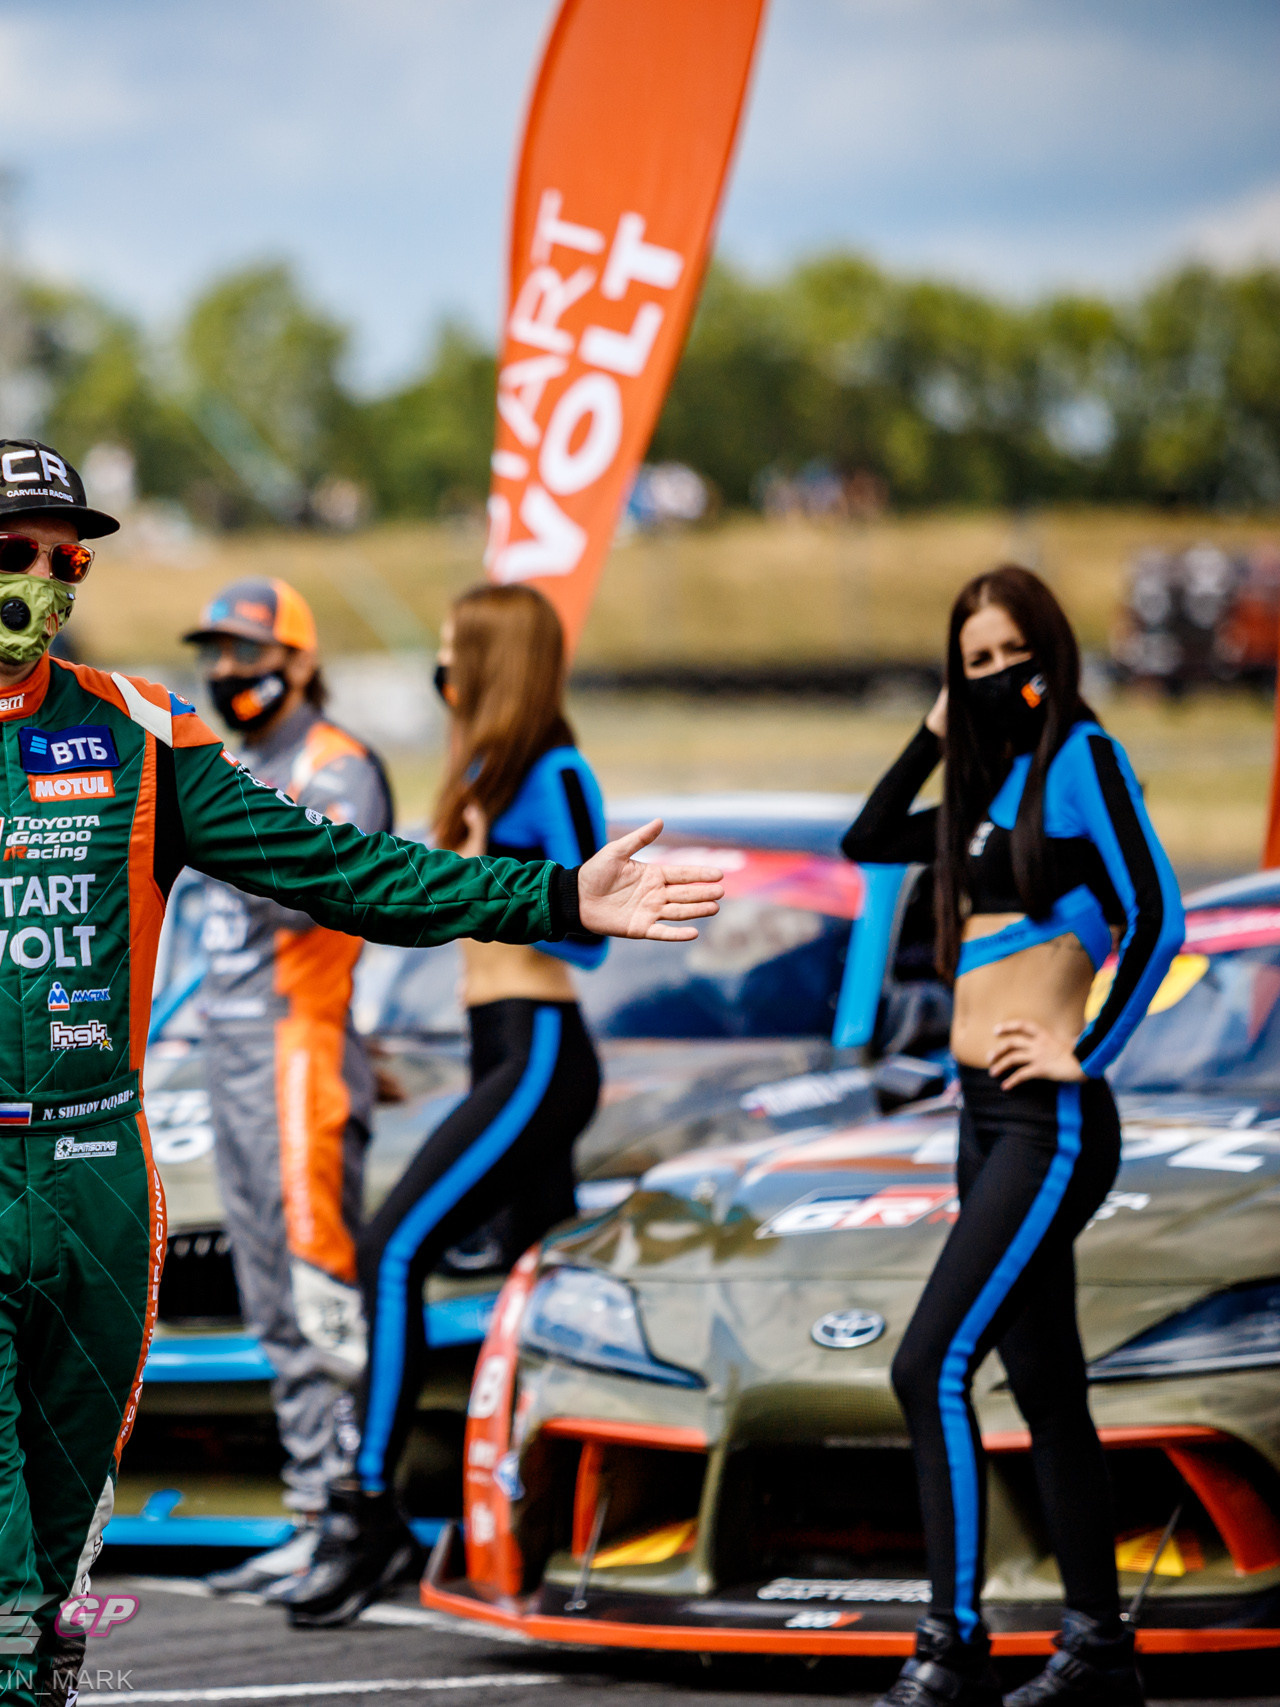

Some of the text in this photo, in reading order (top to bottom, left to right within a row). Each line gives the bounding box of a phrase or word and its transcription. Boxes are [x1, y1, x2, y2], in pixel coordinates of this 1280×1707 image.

[489, 211, 684, 583] VOLT
[1, 450, 70, 487] CR
[6, 488, 74, 503] CARVILLE RACING
[51, 737, 108, 765] ВТБ
[35, 776, 109, 797] MOTUL
[6, 830, 91, 847] GAZOO
[3, 844, 88, 861] Racing
[52, 1021, 107, 1047] hgk
[43, 1108, 56, 1120] N.
[58, 1101, 100, 1118] SHIKOV
